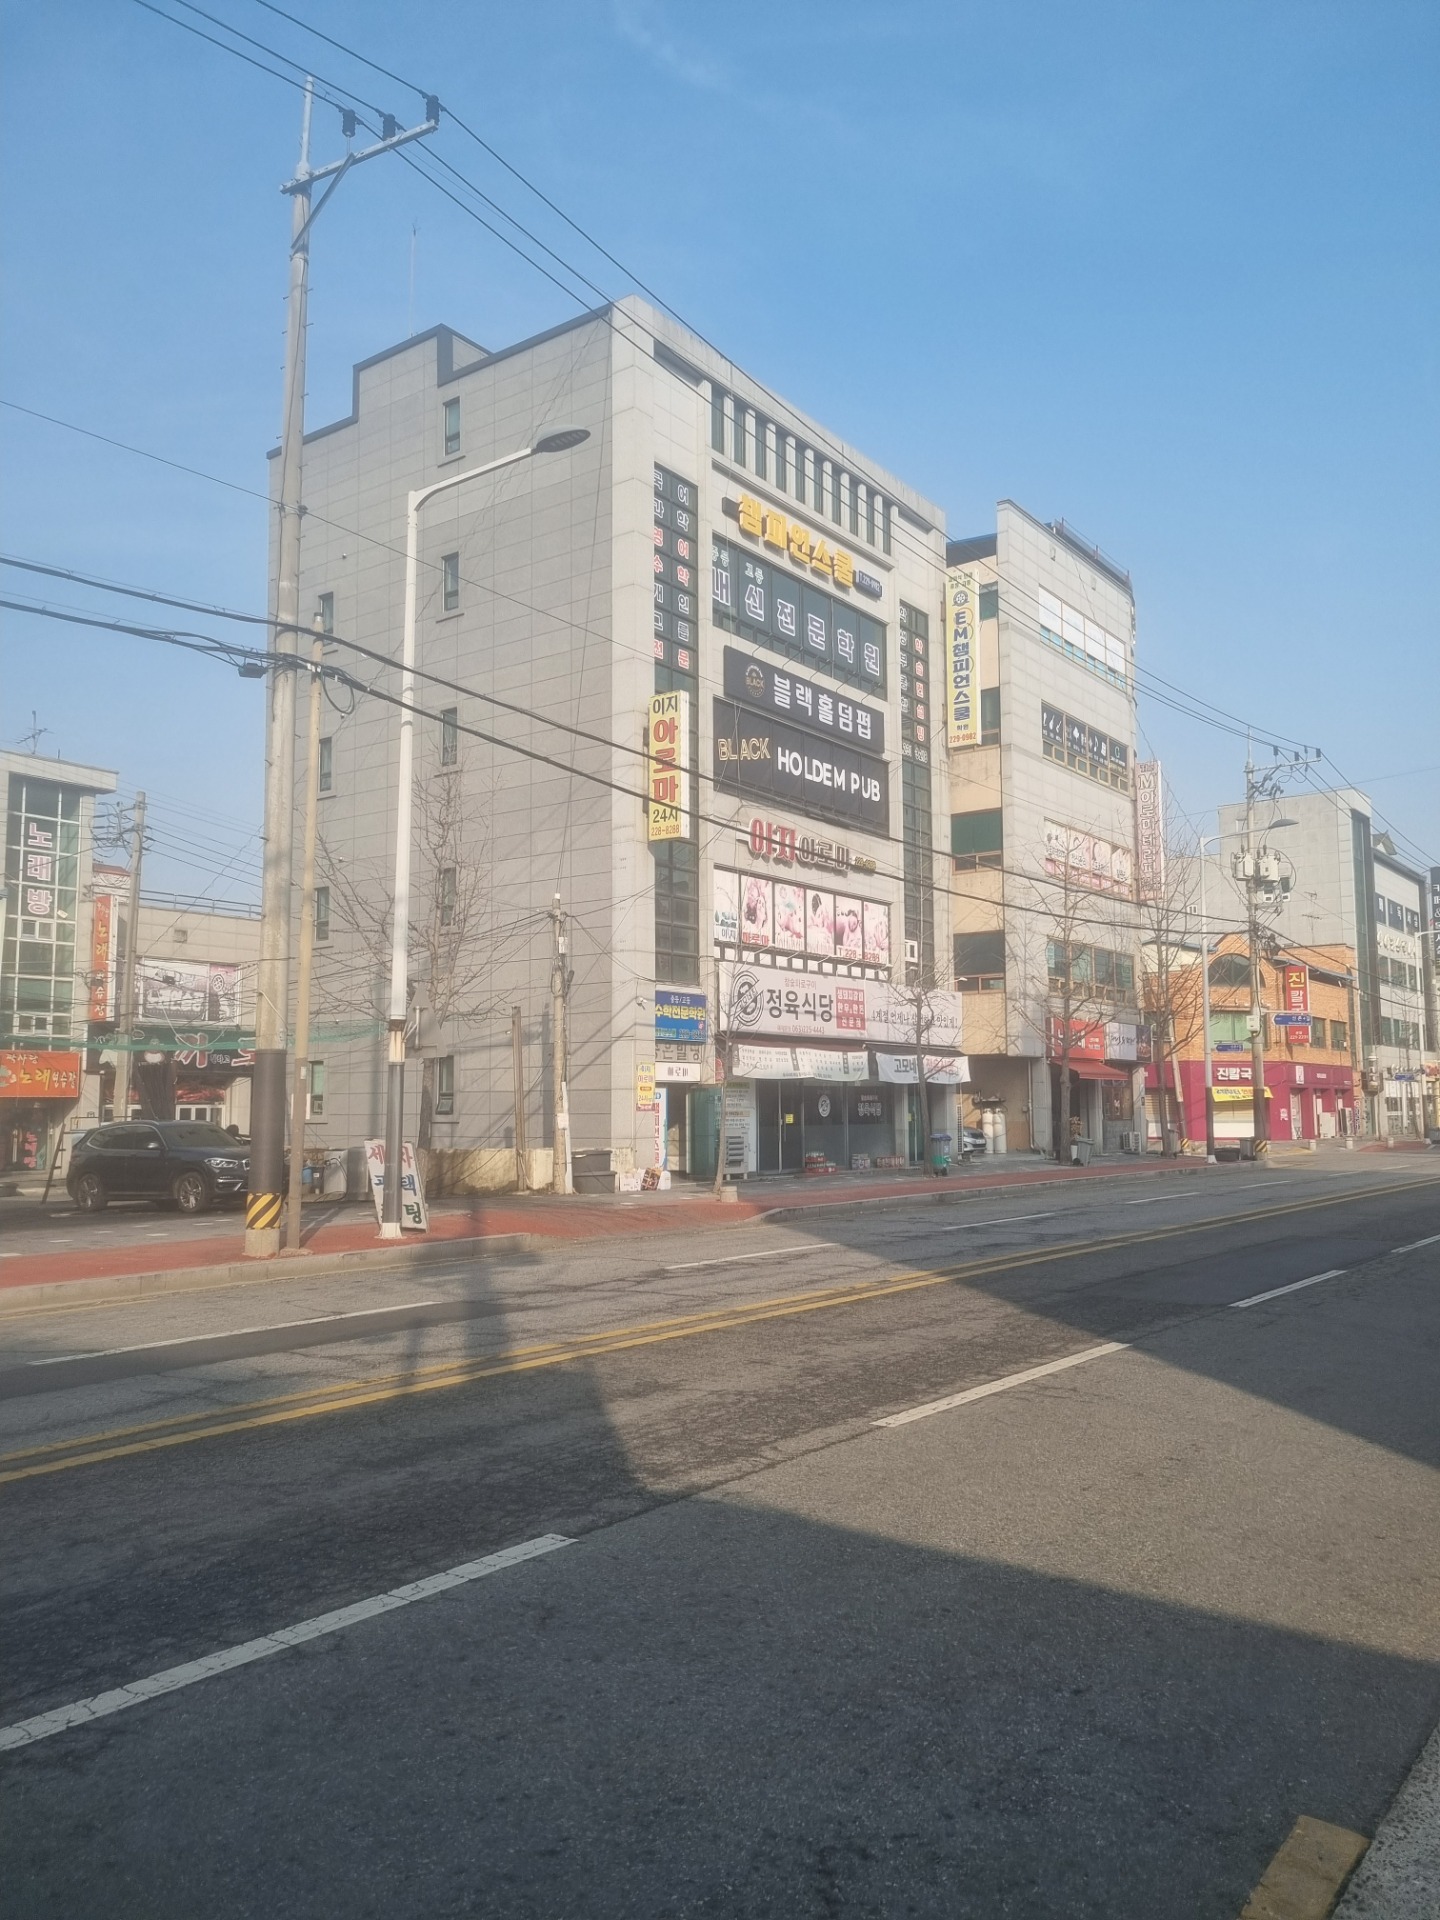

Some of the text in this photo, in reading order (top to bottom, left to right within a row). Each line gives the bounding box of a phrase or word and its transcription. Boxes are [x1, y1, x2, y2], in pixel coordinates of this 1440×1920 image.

[738, 494, 853, 589] 챔피언스쿨
[712, 566, 880, 677] 내신전문학원
[653, 694, 679, 715] 이지
[773, 672, 872, 741] 블랙홀덤펍
[652, 716, 679, 803] 아로마
[717, 737, 881, 802] BLACK HOLDEM PUB
[652, 808, 679, 824] 24시
[27, 822, 53, 915] 노래방
[655, 1003, 706, 1020] 수학전문학원
[767, 988, 834, 1022] 정육식당
